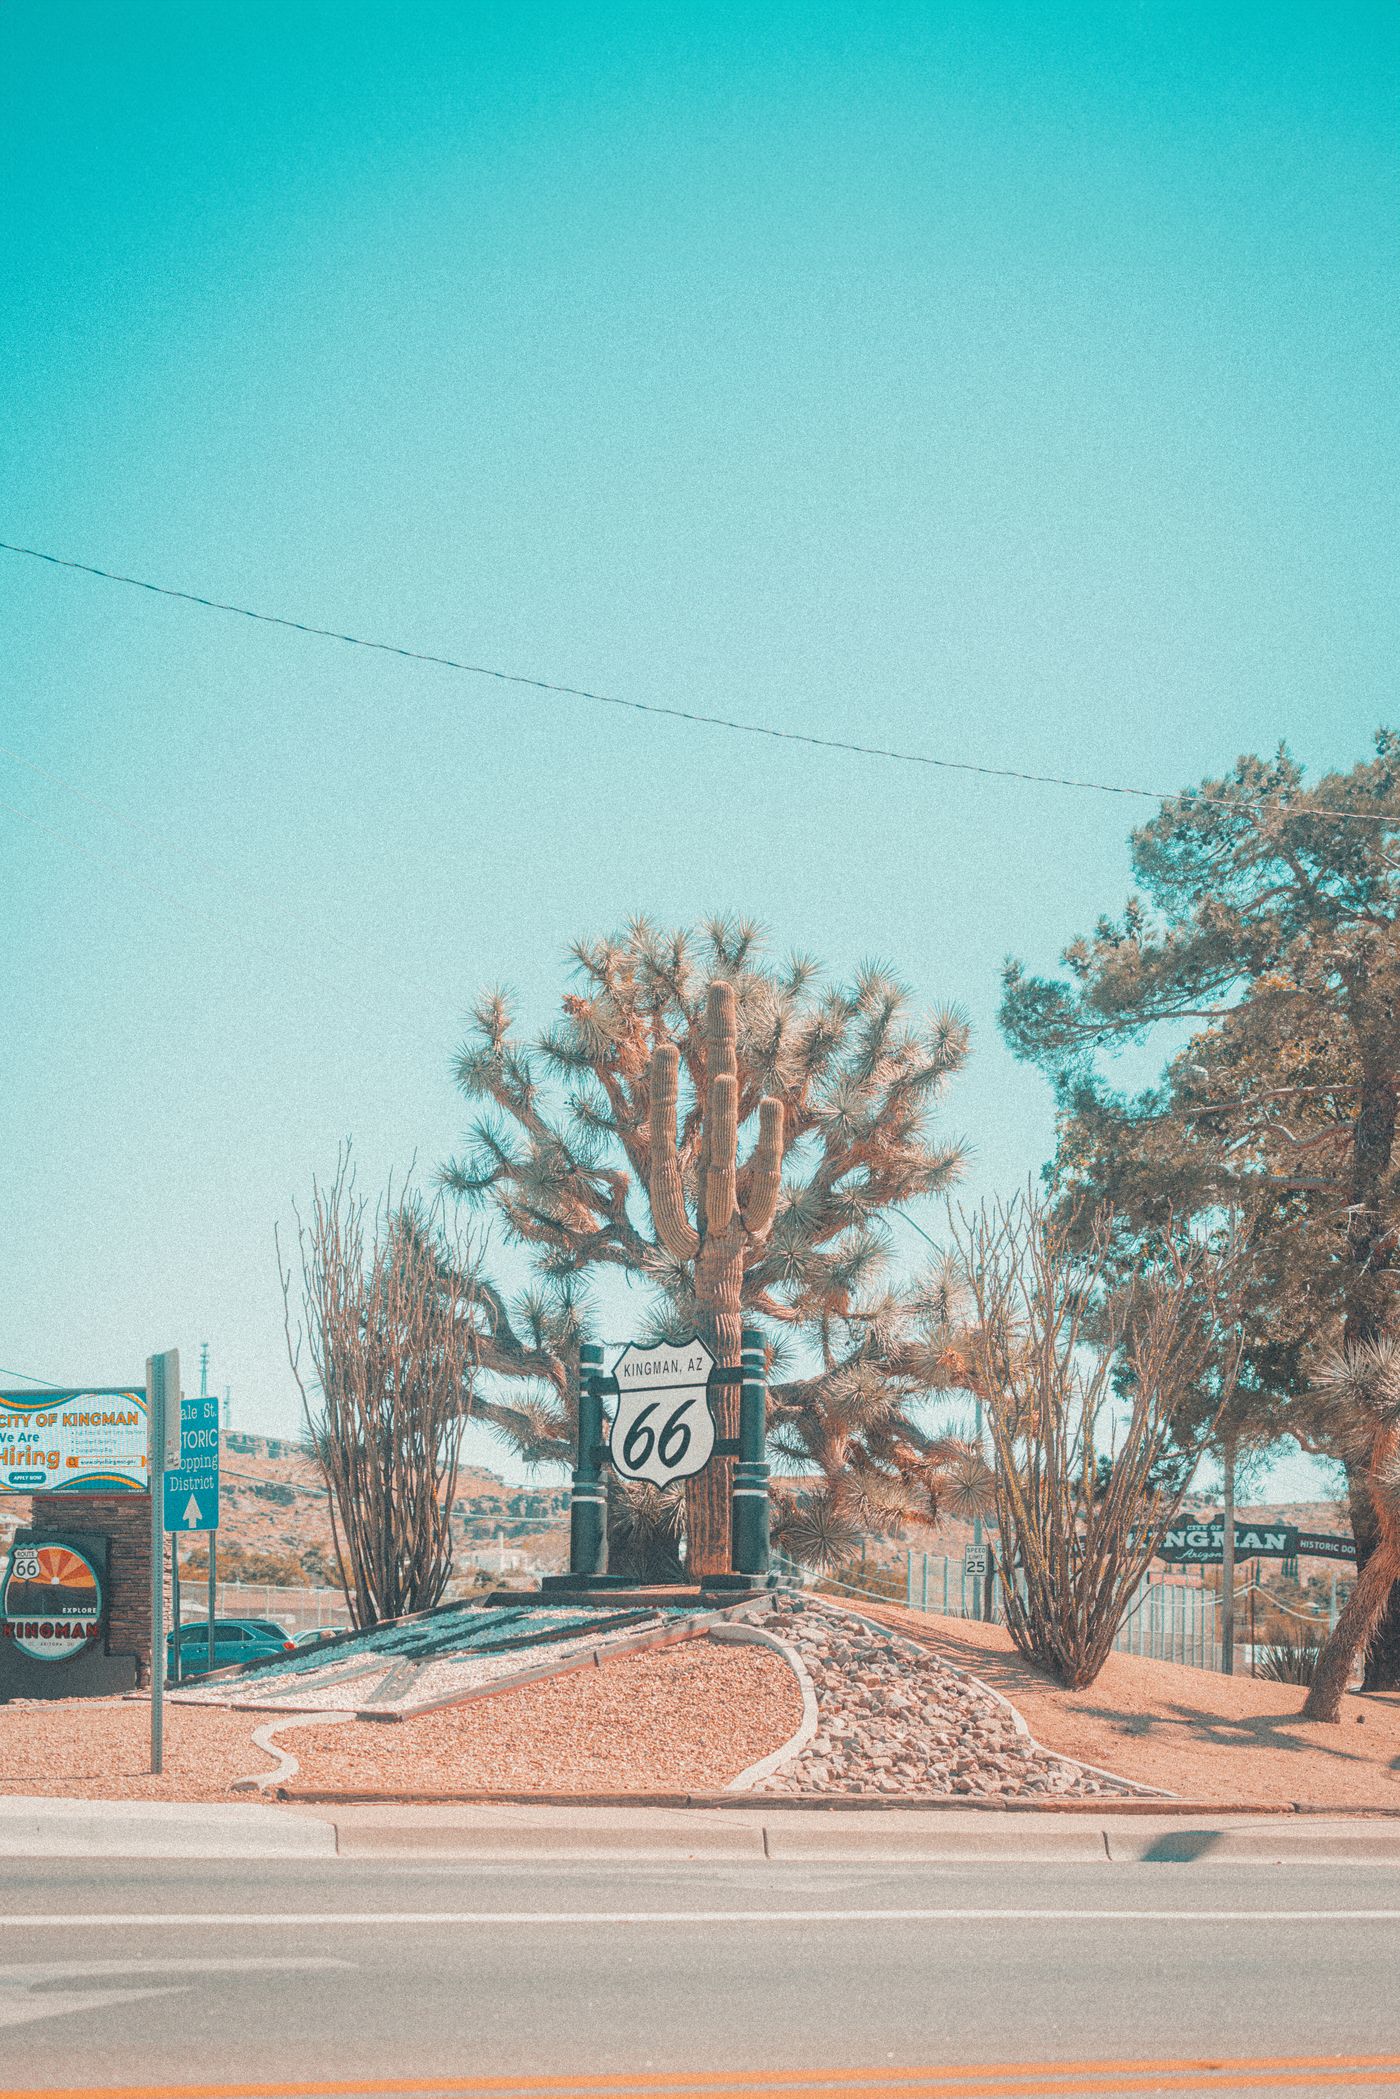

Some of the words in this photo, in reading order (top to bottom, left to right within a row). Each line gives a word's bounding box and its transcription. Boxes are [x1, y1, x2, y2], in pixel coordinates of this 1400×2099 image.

[623, 1359, 682, 1377] KINGMAN,
[687, 1357, 703, 1372] AZ
[0, 1414, 32, 1428] CITY
[35, 1413, 58, 1427] OF
[62, 1411, 139, 1427] KINGMAN
[180, 1405, 198, 1420] ale
[203, 1403, 217, 1418] St.
[17, 1432, 40, 1442] Are
[180, 1428, 218, 1449] TORIC
[623, 1399, 697, 1471] 66
[180, 1453, 218, 1473] opping
[169, 1475, 215, 1492] District
[1175, 1548, 1224, 1561] Arizon
[1300, 1540, 1340, 1553] HISTORIC
[16, 1560, 37, 1576] 66
[966, 1561, 986, 1573] 25
[2, 1621, 99, 1639] KINGMAN
